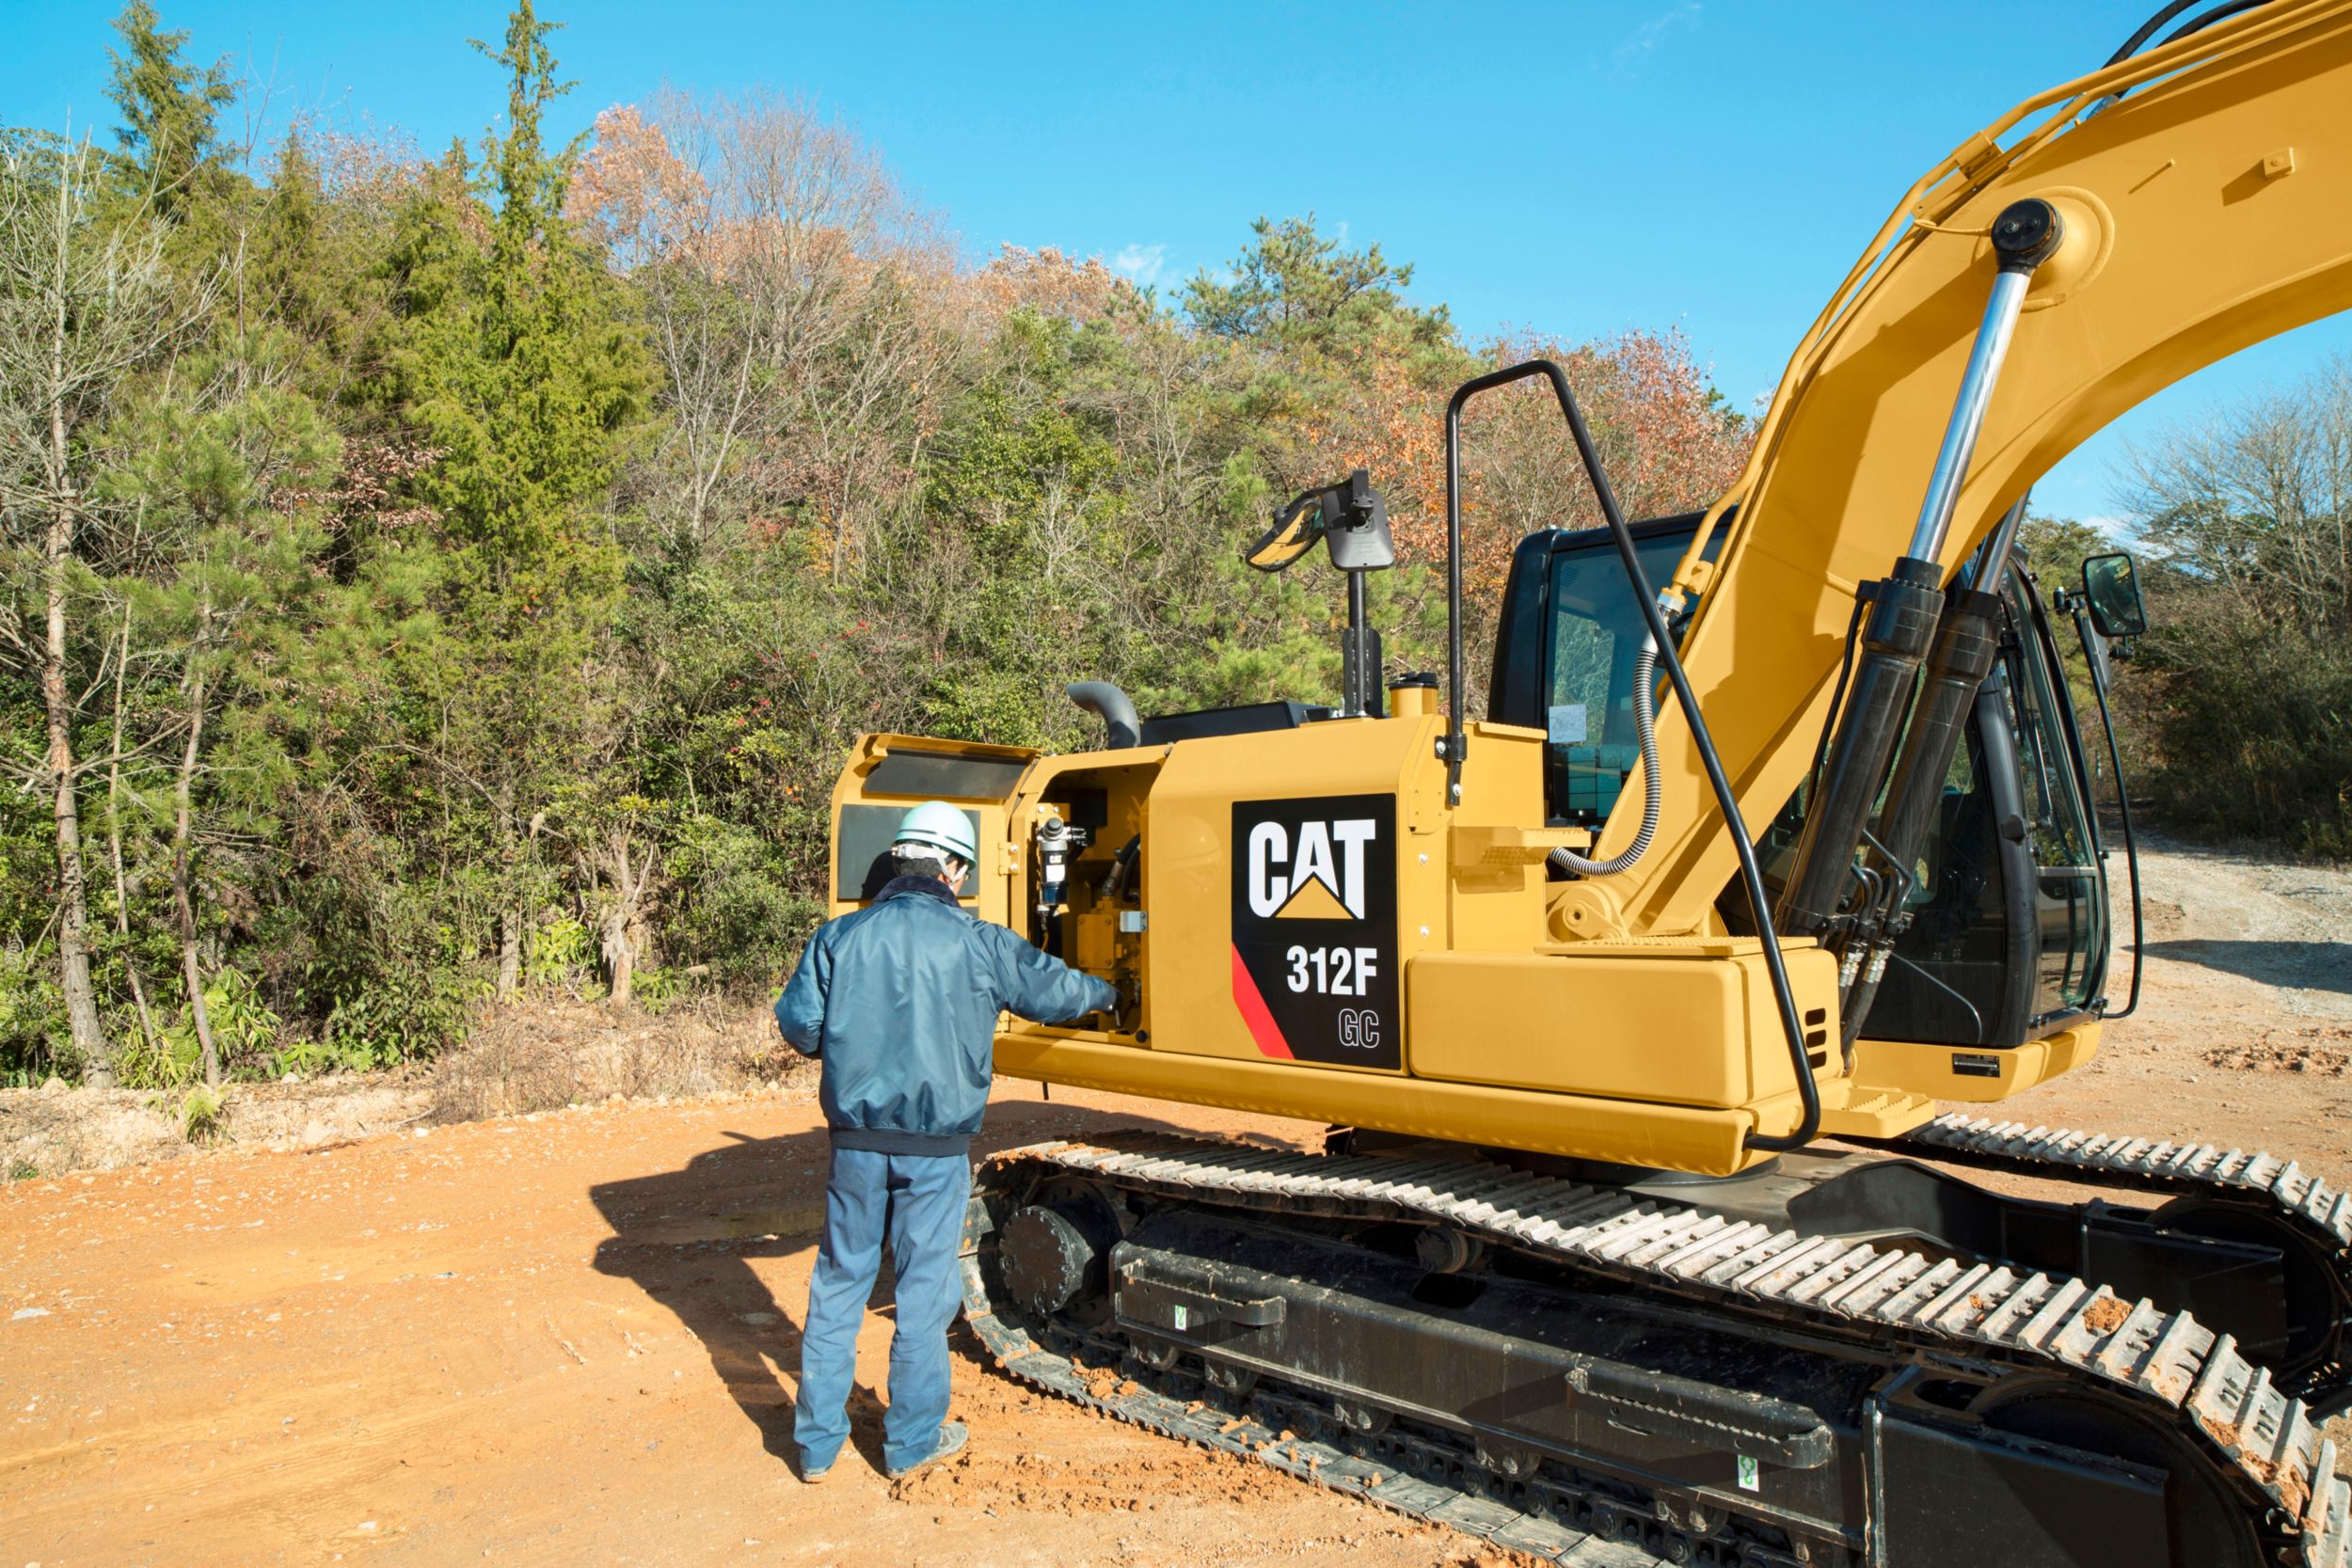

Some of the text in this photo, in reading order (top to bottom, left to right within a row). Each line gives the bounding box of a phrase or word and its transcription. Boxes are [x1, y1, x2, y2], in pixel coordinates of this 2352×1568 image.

[1248, 819, 1375, 919] CAT
[1286, 945, 1377, 996] 312F
[1339, 1008, 1379, 1048] GC
